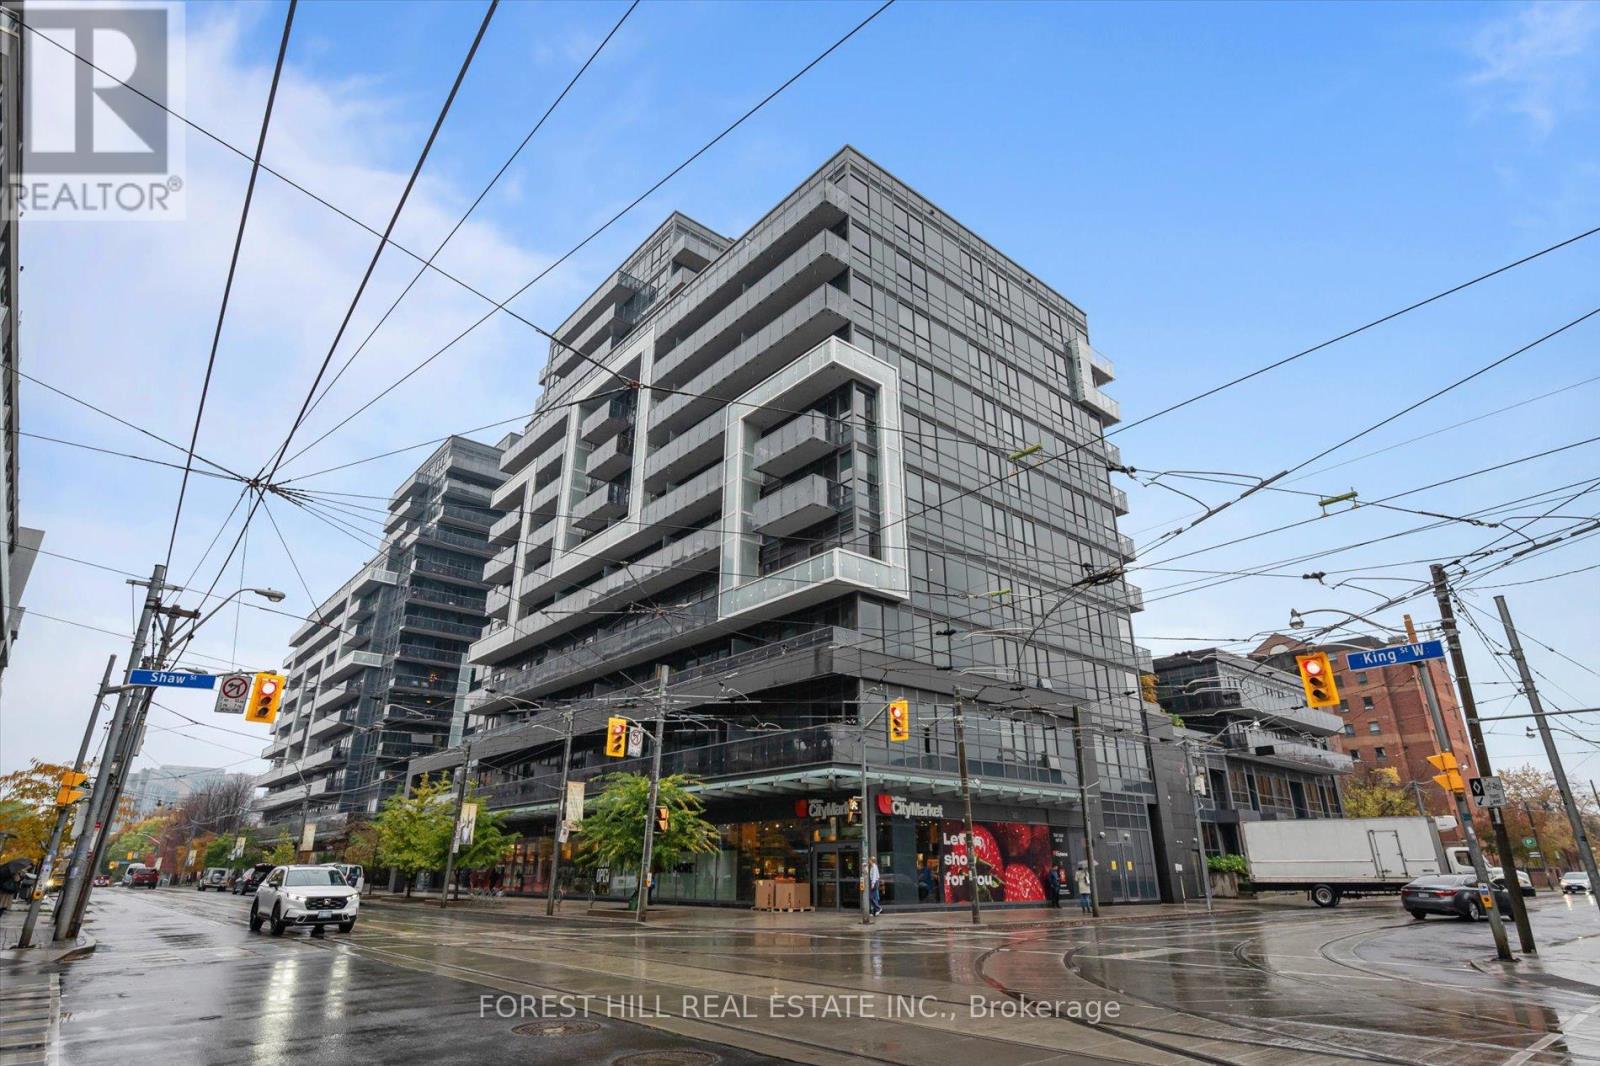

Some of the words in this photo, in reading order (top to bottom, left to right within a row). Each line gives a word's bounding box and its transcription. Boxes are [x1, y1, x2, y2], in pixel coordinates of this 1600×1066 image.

[1363, 651, 1397, 664] King
[1400, 646, 1409, 654] St
[1411, 644, 1424, 657] W
[150, 672, 186, 684] Shaw
[809, 802, 849, 819] CityMar
[892, 801, 943, 819] CityMarket
[943, 833, 966, 846] Let
[944, 852, 976, 866] sho
[945, 872, 966, 886] for
[973, 875, 992, 887] ou
